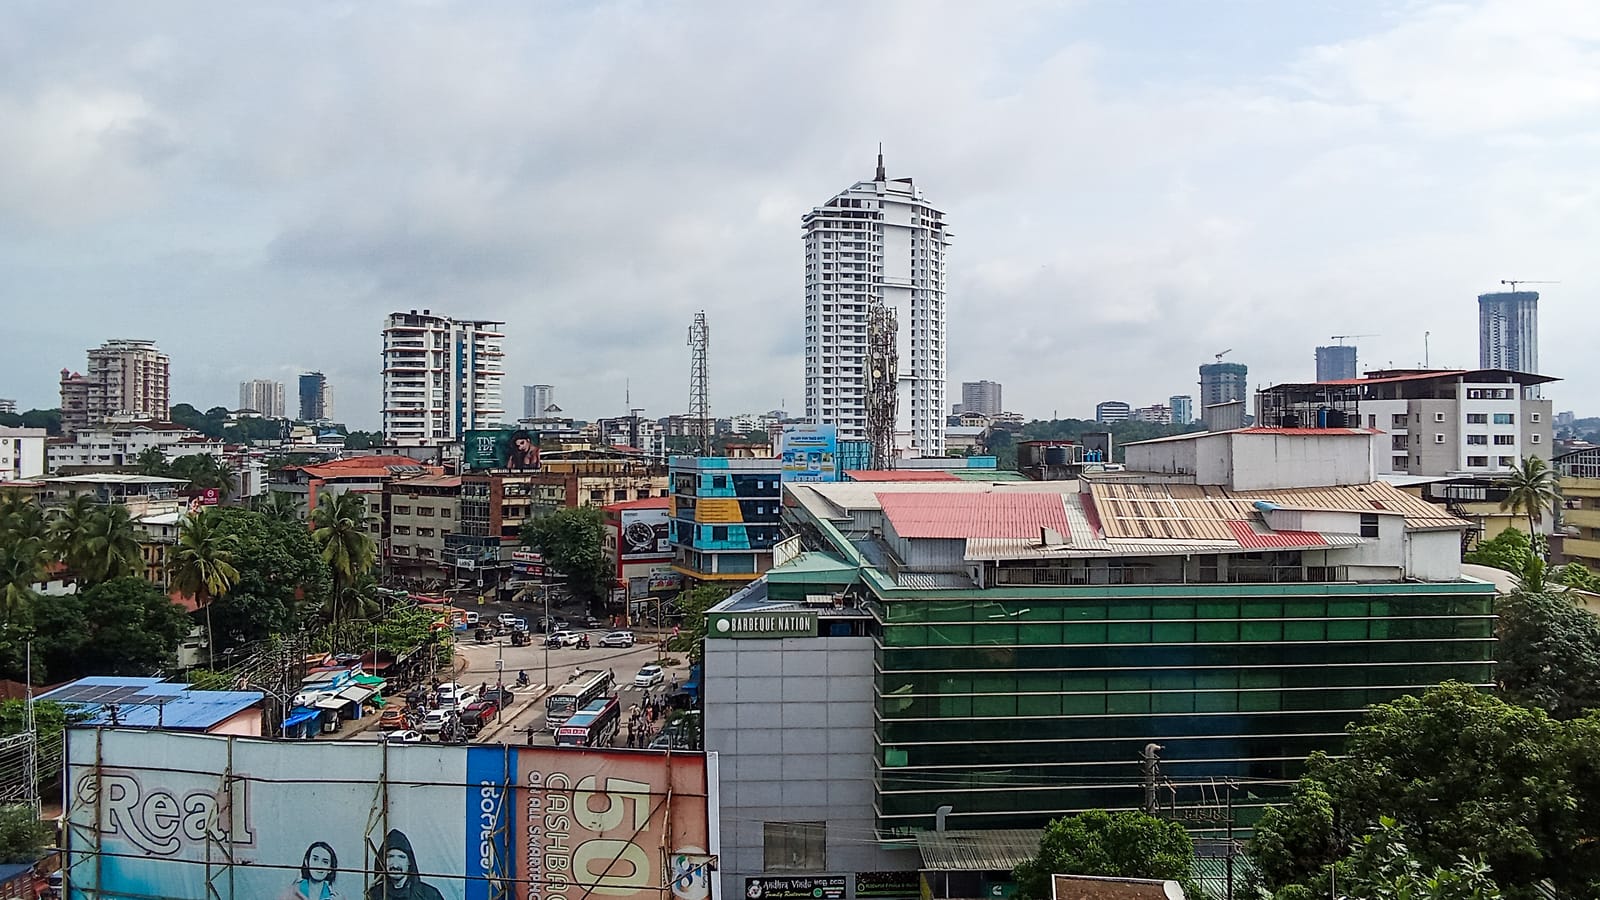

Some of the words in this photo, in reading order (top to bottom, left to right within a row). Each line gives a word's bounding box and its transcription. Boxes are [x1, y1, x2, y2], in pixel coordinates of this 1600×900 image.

[731, 617, 775, 632] BARBEQUE
[778, 616, 810, 631] NATION
[528, 770, 541, 794] ON
[77, 774, 253, 856] Real
[528, 797, 541, 822] ALL
[572, 775, 651, 897] 50
